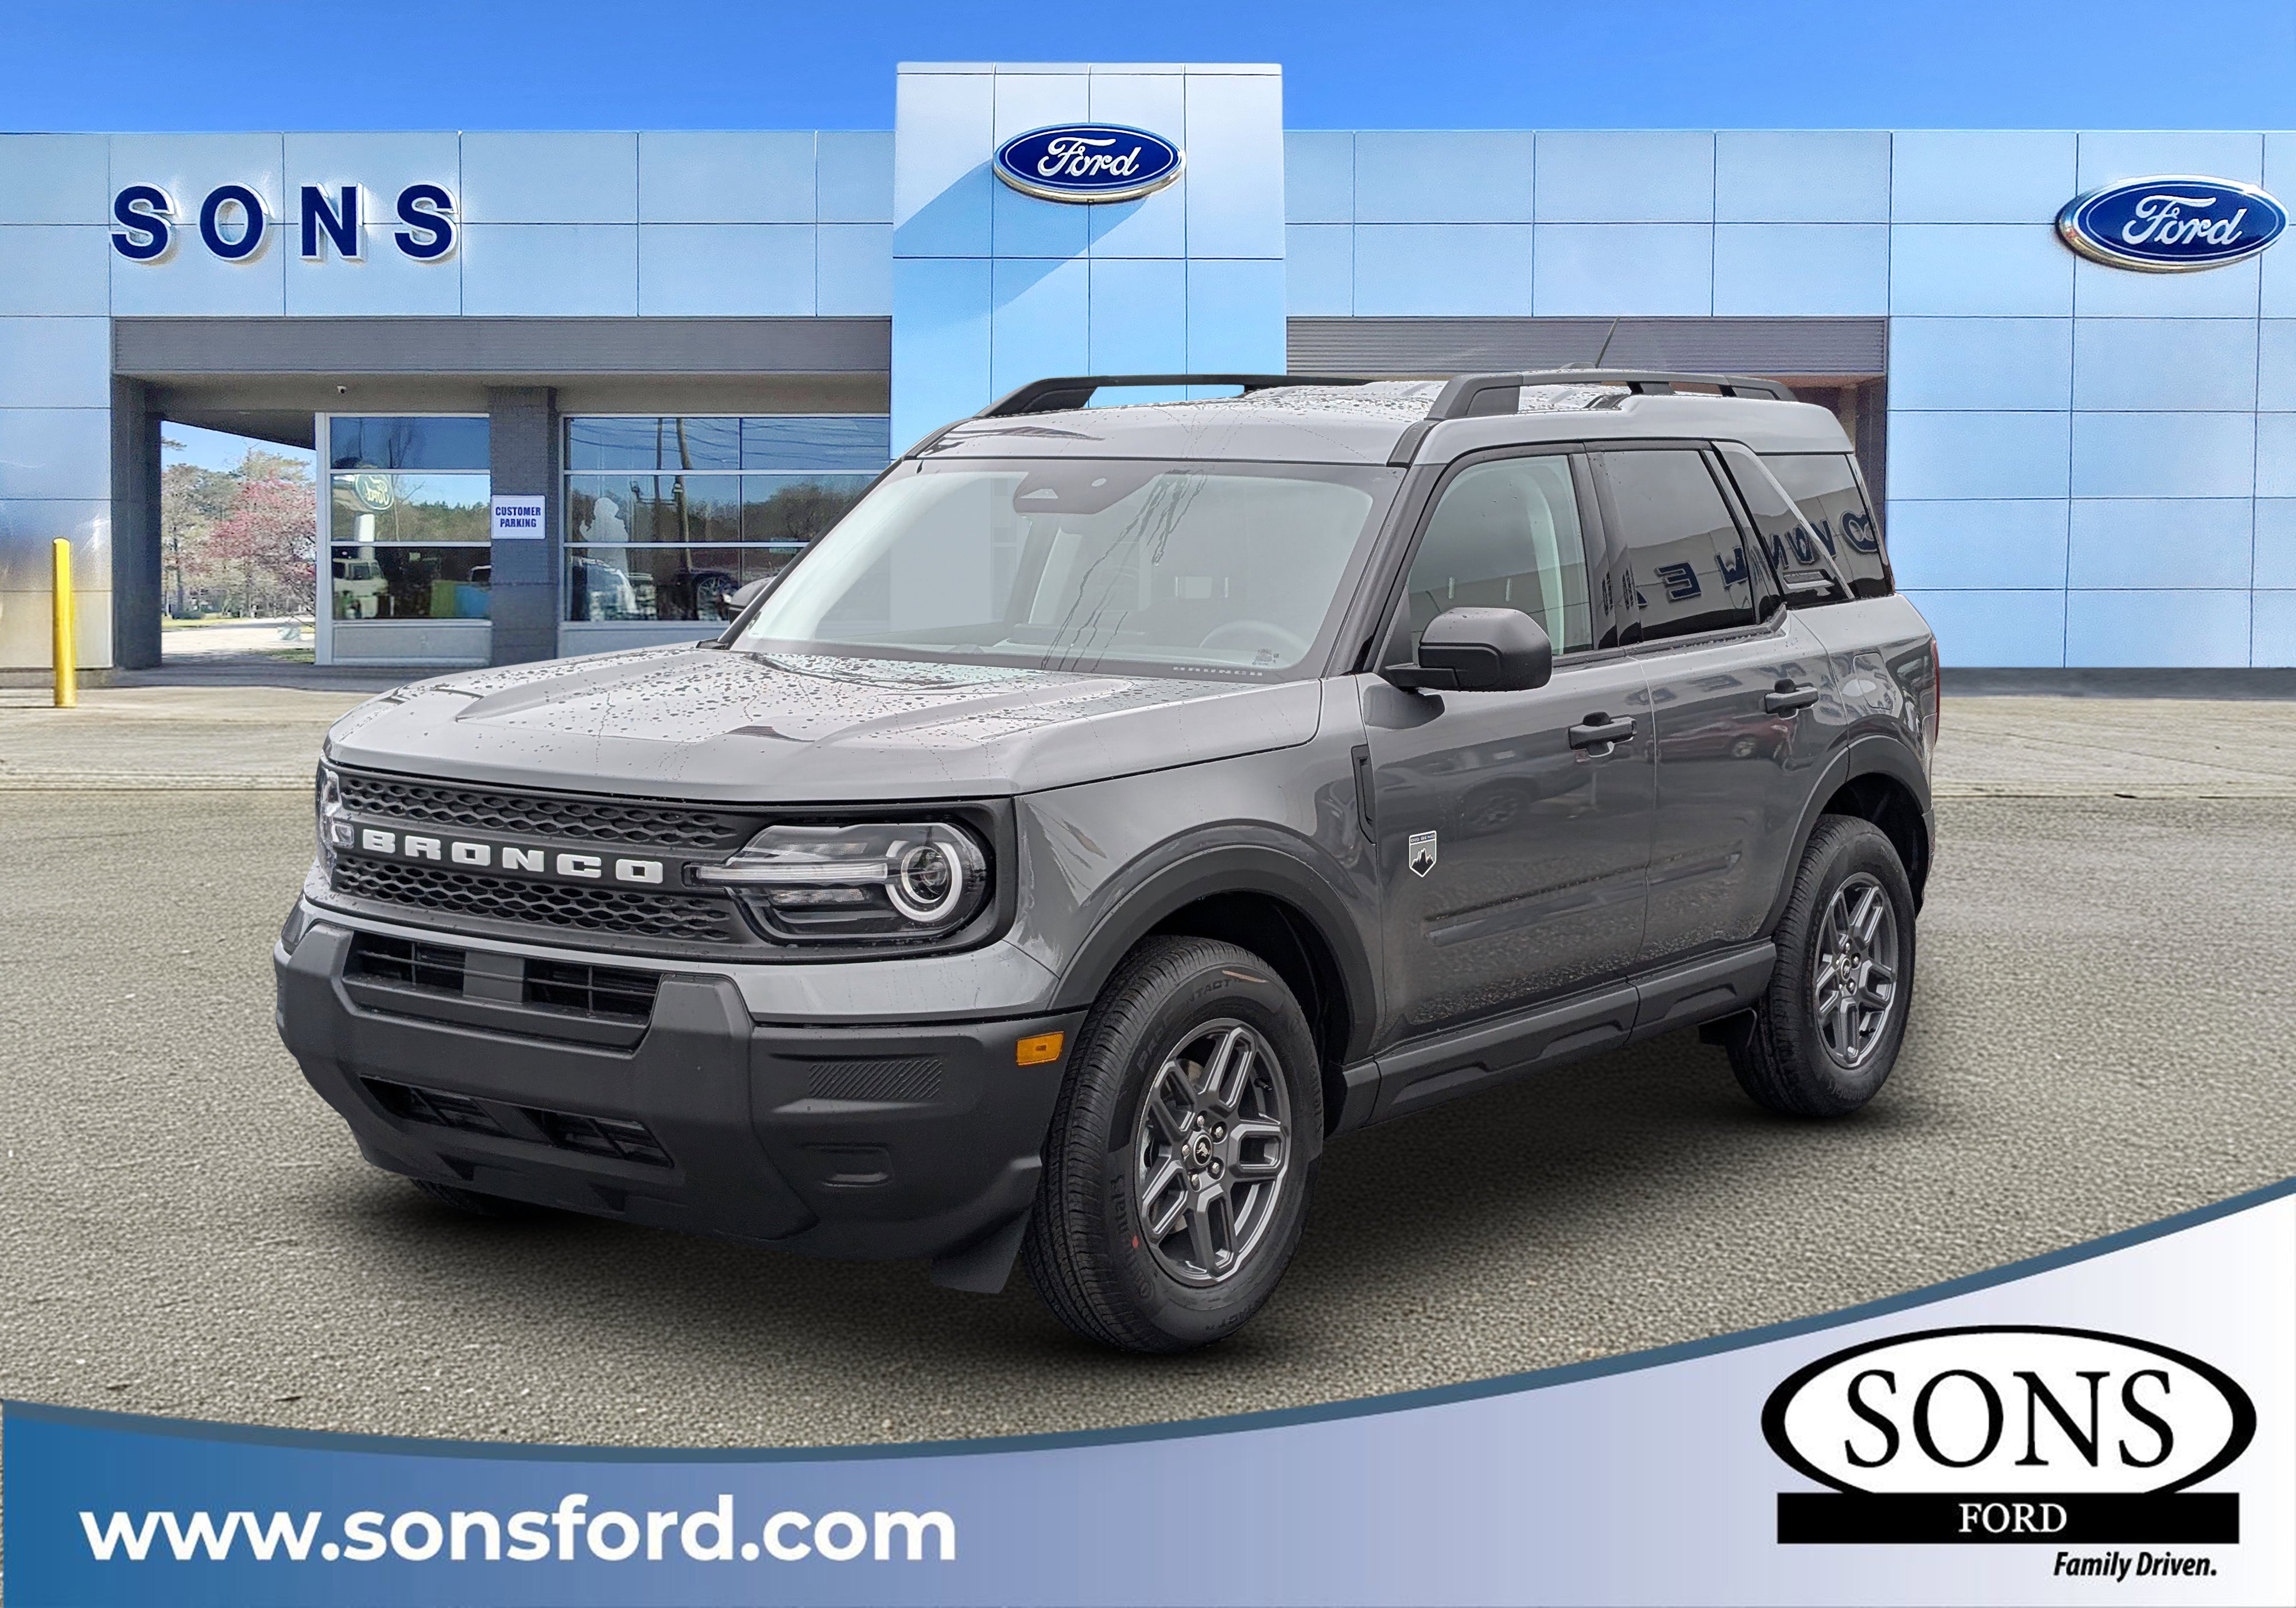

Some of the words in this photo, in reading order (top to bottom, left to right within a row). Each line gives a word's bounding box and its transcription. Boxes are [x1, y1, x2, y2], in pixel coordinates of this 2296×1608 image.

[1037, 136, 1142, 177] Ford
[111, 183, 455, 261] SONS
[2122, 194, 2247, 245] Ford
[495, 507, 541, 515] CUSTOMER
[500, 518, 537, 527] PARKING
[362, 829, 664, 884] BRONCO
